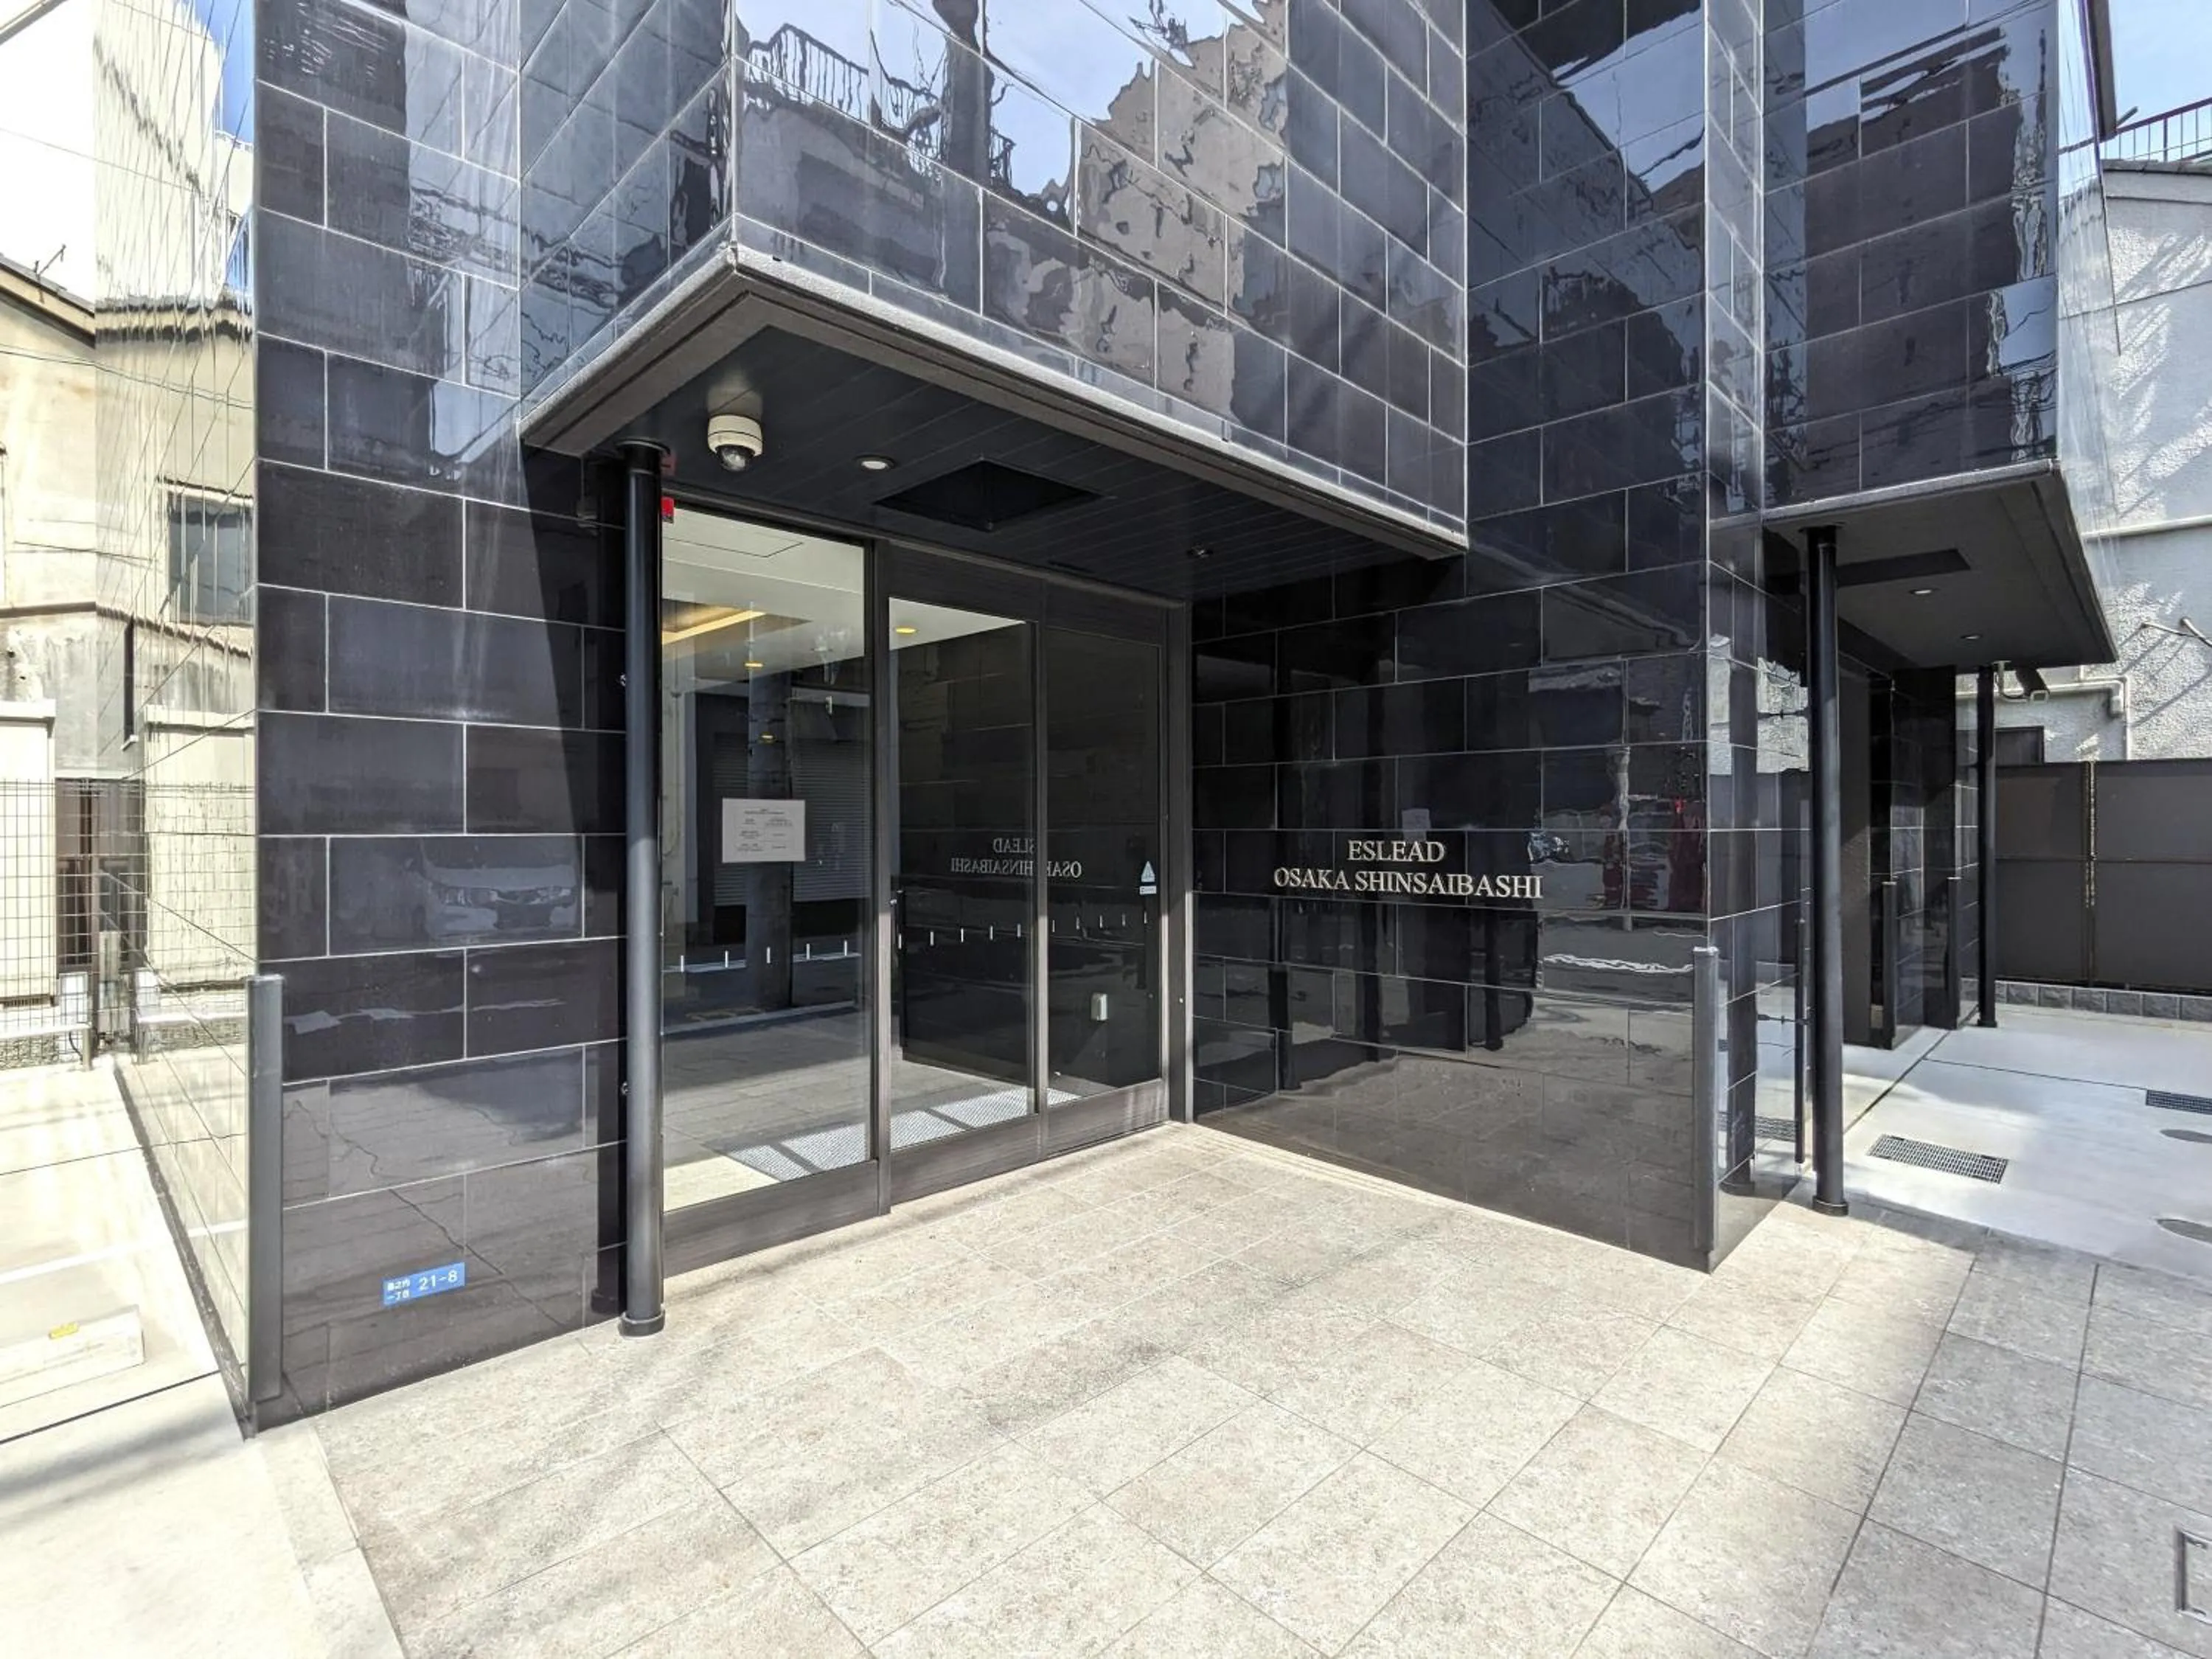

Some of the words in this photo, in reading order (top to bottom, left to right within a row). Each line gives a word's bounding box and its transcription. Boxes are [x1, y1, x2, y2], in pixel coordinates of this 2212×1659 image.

[1347, 840, 1446, 863] ESLEAD
[1273, 867, 1350, 891] OSAKA
[1354, 871, 1544, 899] SHINSAIBASHI
[419, 1270, 457, 1290] 21-8
